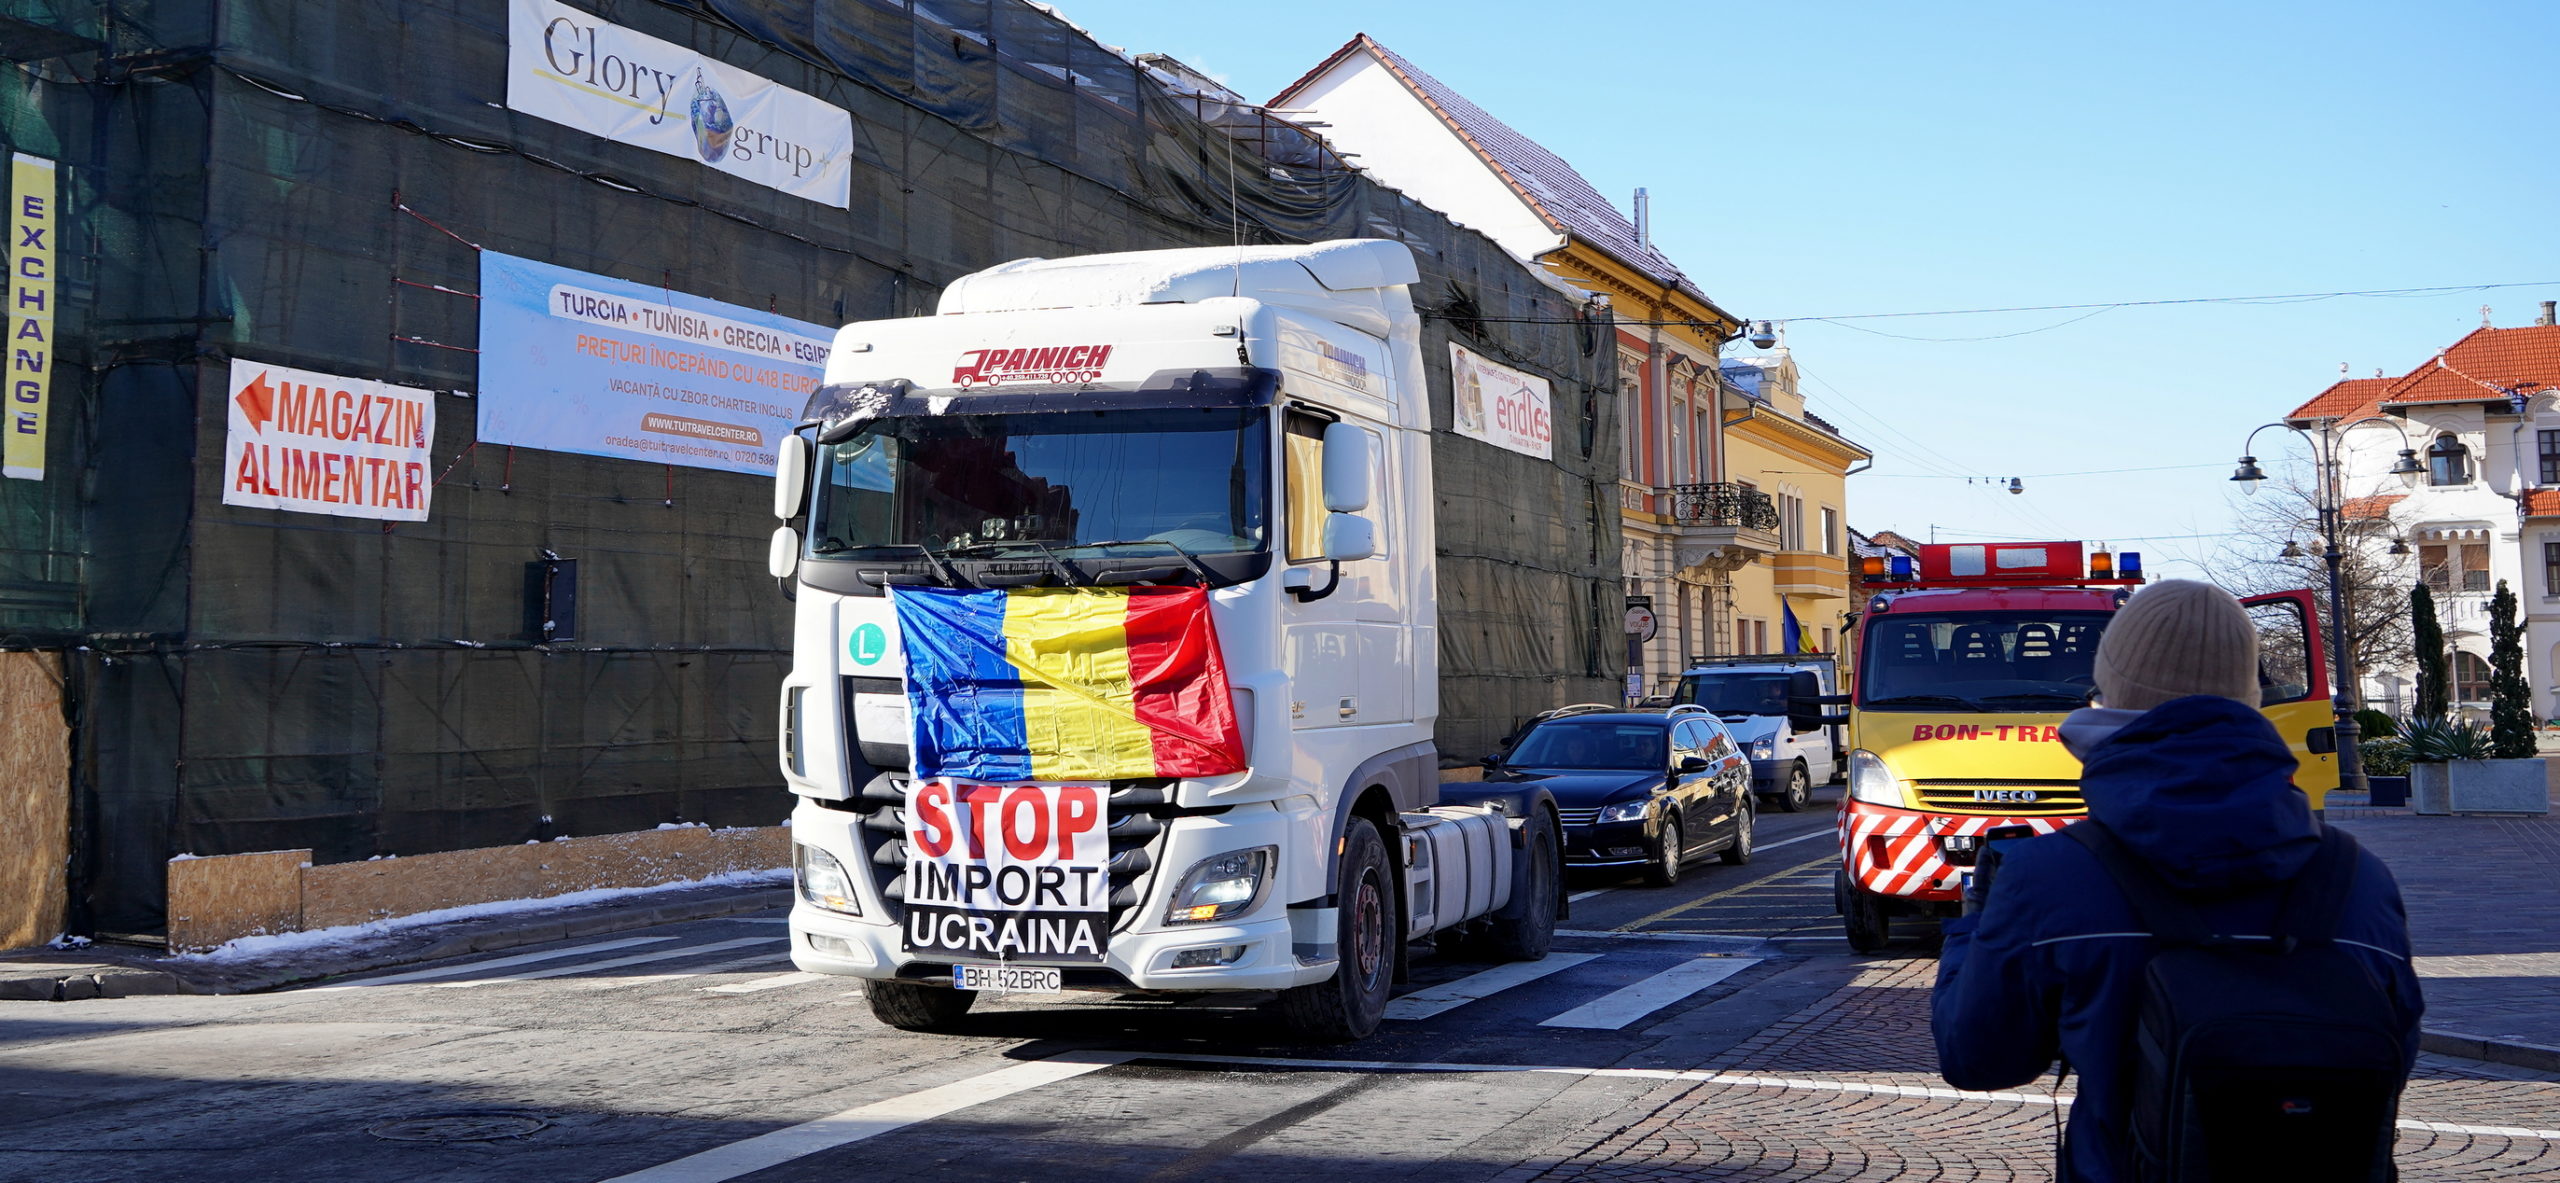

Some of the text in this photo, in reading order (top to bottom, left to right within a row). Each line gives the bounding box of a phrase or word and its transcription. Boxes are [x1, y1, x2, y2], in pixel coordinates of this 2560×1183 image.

[543, 16, 812, 178] Glory grup
[15, 195, 46, 435] EXCHANGE
[560, 291, 628, 325] TURCIA
[643, 308, 709, 341] TUNISIA
[723, 326, 782, 355] GRECIA
[983, 345, 1113, 373] PAINICH
[732, 363, 753, 384] CU
[756, 368, 779, 389] 418
[782, 373, 820, 395] EURO
[277, 381, 425, 449] MAGAZIN
[662, 386, 678, 401] CU
[680, 390, 709, 406] ZBOR
[710, 394, 757, 415] CHARTER
[759, 403, 793, 420] INCLUS
[647, 416, 758, 443] WWW.TUITRAVELCENTER.RO
[605, 435, 729, 460] oradea@tuitravelcenter.ro
[735, 450, 756, 464] 0720
[235, 441, 425, 510] ALIMENTAR
[858, 627, 875, 660] L
[1974, 790, 2037, 803] IVECO
[912, 781, 1098, 861] STOP
[913, 862, 1099, 907] IMPORT
[910, 910, 1099, 955] UCRAINA
[965, 968, 991, 988] BH
